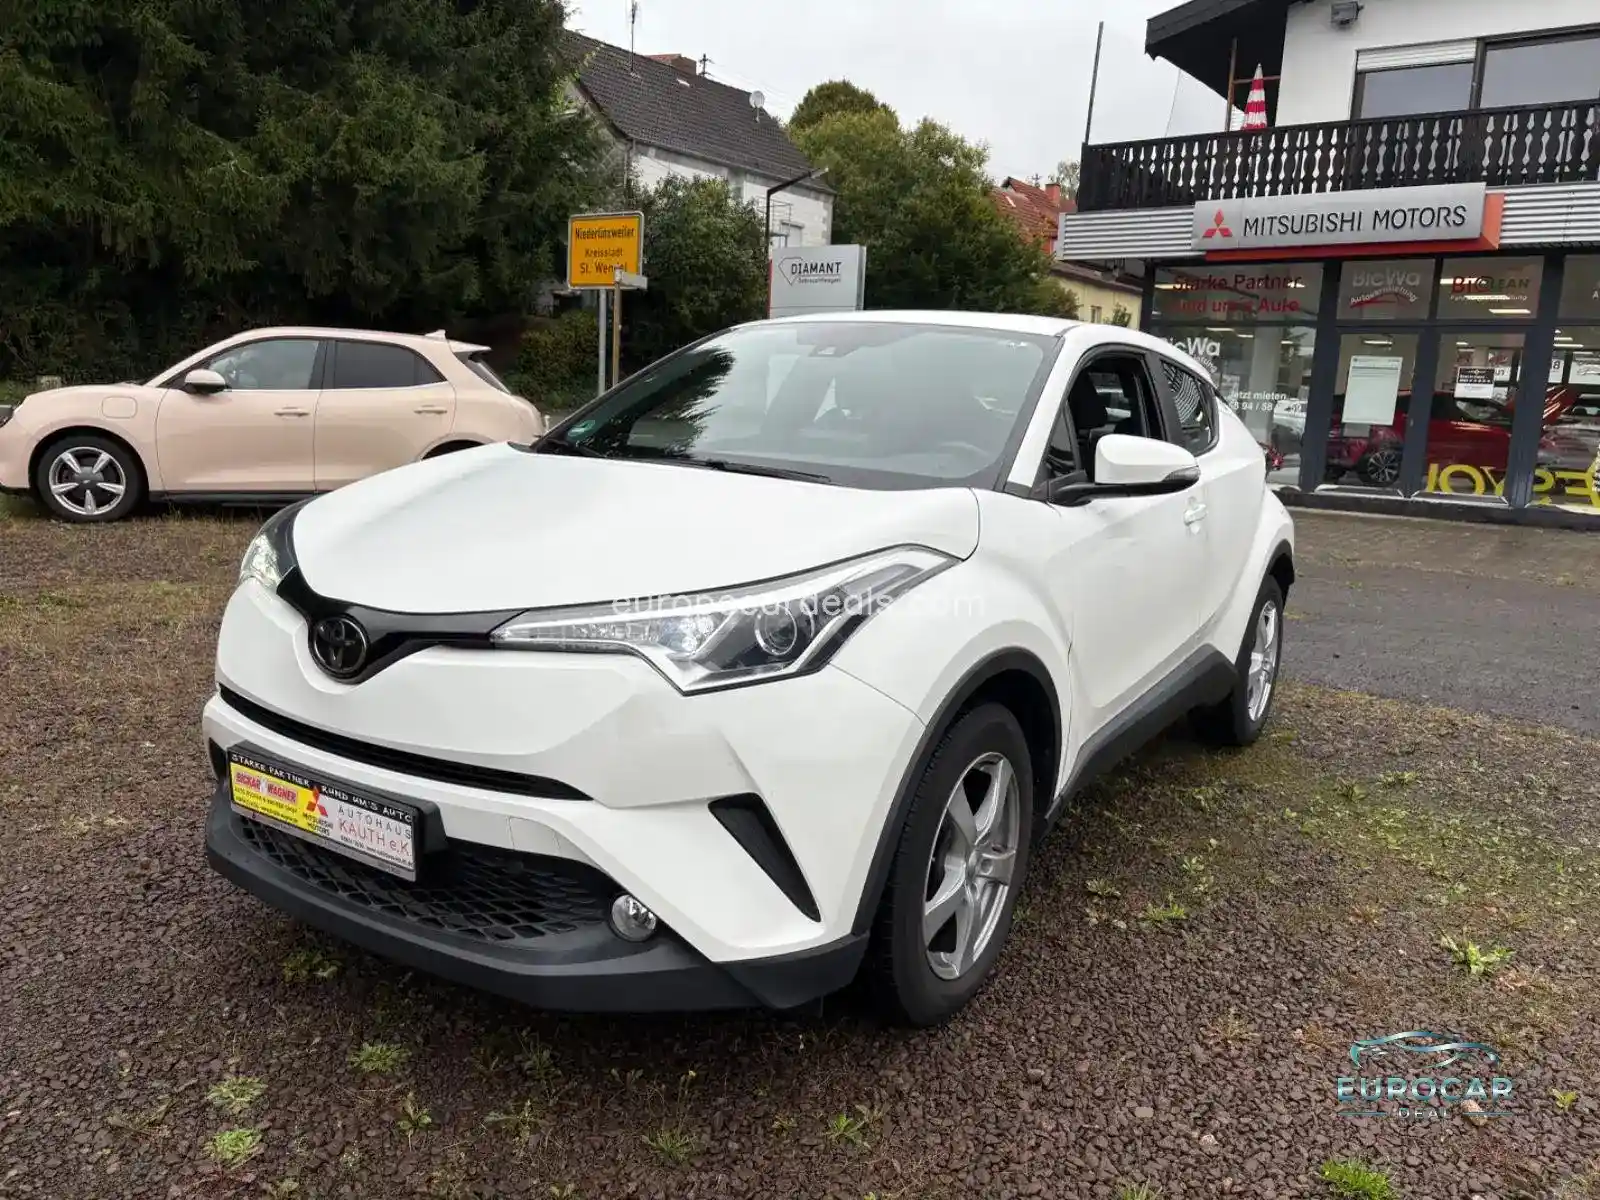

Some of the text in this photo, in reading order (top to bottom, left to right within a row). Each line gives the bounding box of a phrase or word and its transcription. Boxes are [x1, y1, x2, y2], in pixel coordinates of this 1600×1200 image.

[1243, 205, 1467, 236] MITSUBISHI MOTORS
[585, 247, 623, 258] Kreisstadt
[791, 261, 842, 275] DIAMANT
[1253, 390, 1287, 401] mieten
[231, 754, 266, 772] STARKE
[269, 766, 310, 787] PARTNER
[321, 785, 349, 801] RUND
[267, 783, 298, 803] WAGNER
[338, 804, 413, 840] AUTOHAUS
[340, 819, 385, 846] KAUTH
